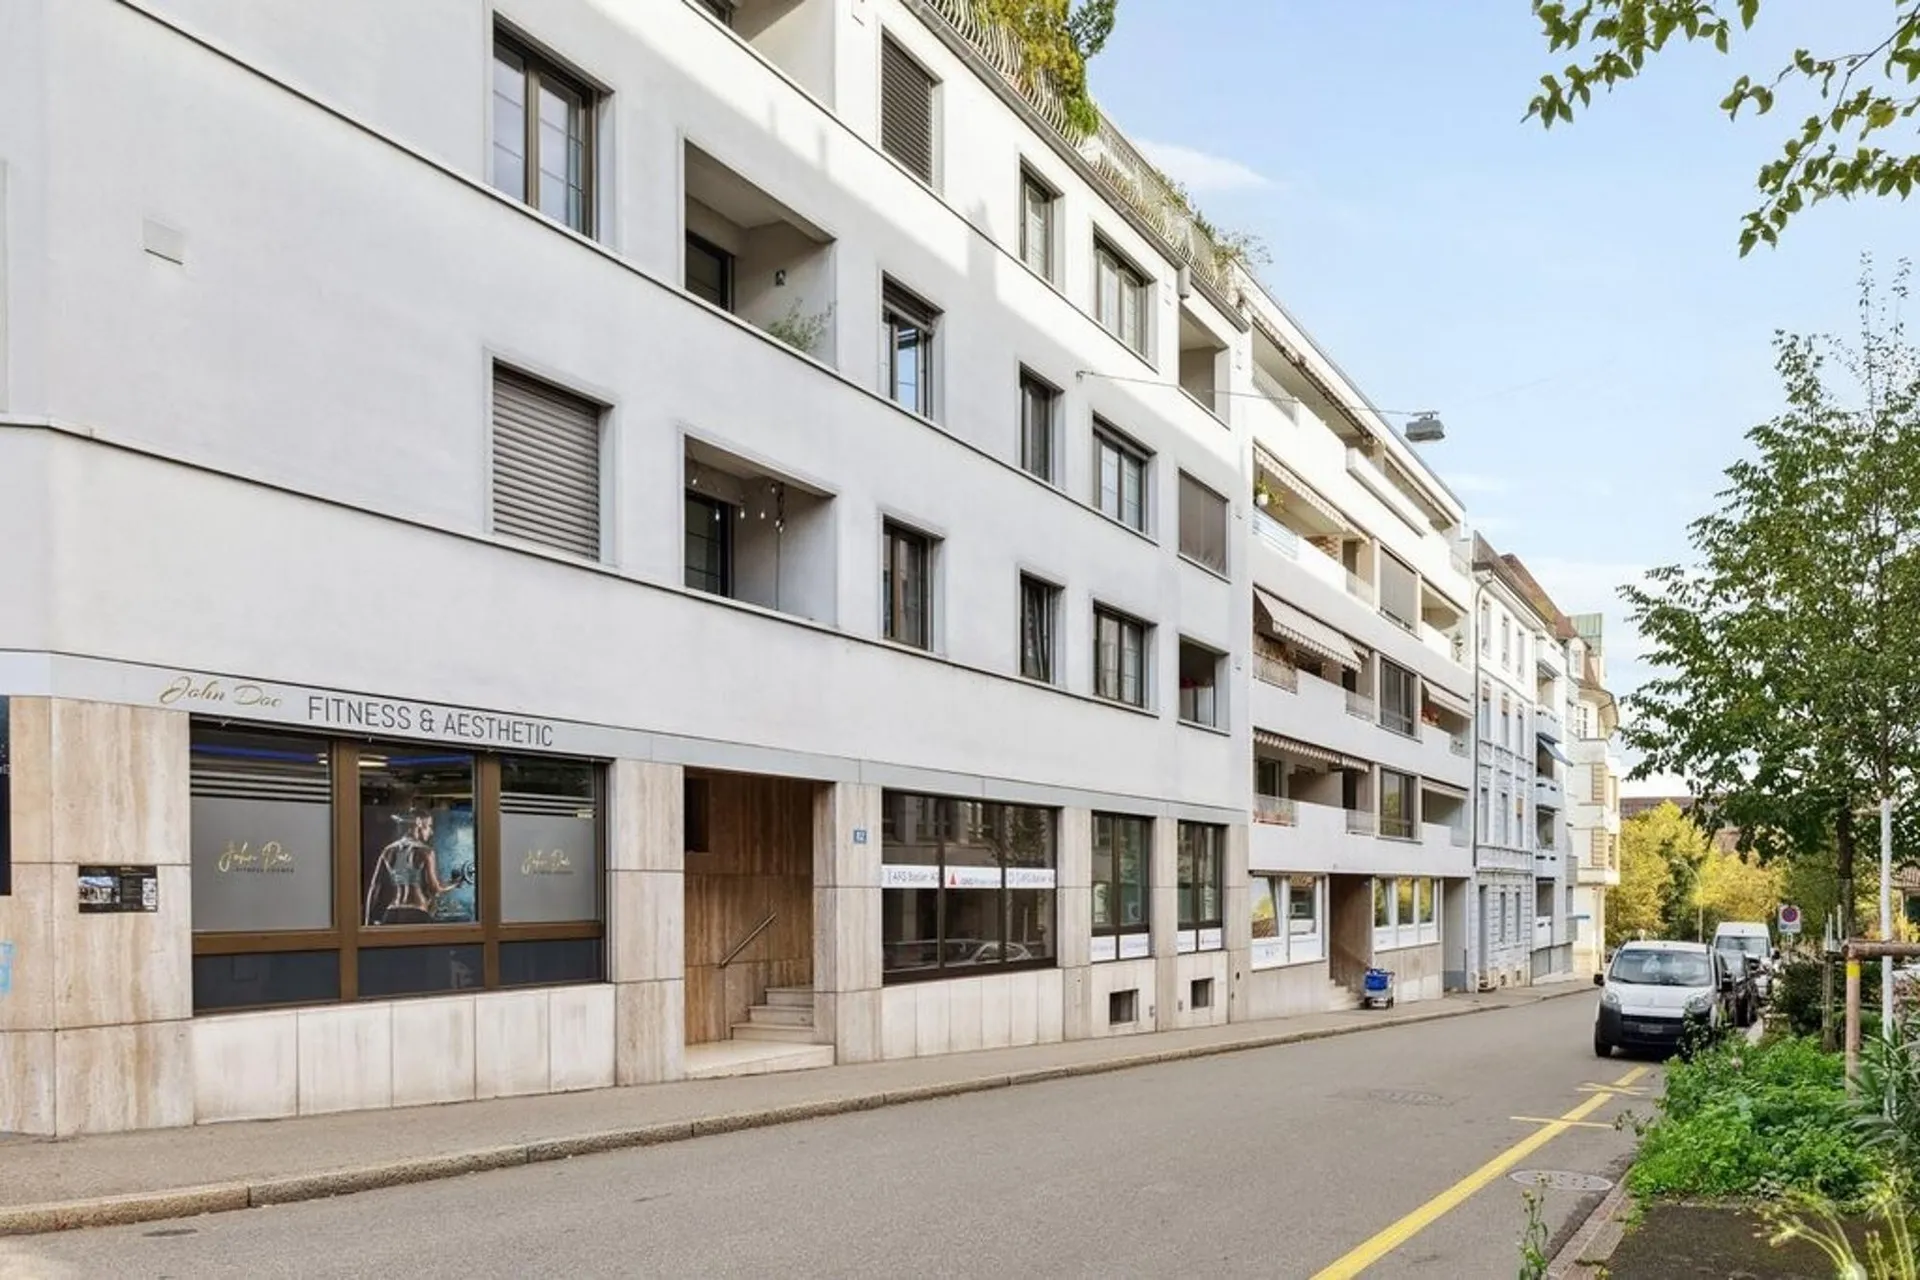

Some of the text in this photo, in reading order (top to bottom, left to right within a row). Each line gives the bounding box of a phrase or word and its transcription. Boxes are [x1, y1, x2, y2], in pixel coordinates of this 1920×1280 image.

[160, 676, 226, 705] John
[308, 695, 412, 731] FITNESS
[419, 708, 435, 734] &
[443, 712, 554, 748] AESTHETIC
